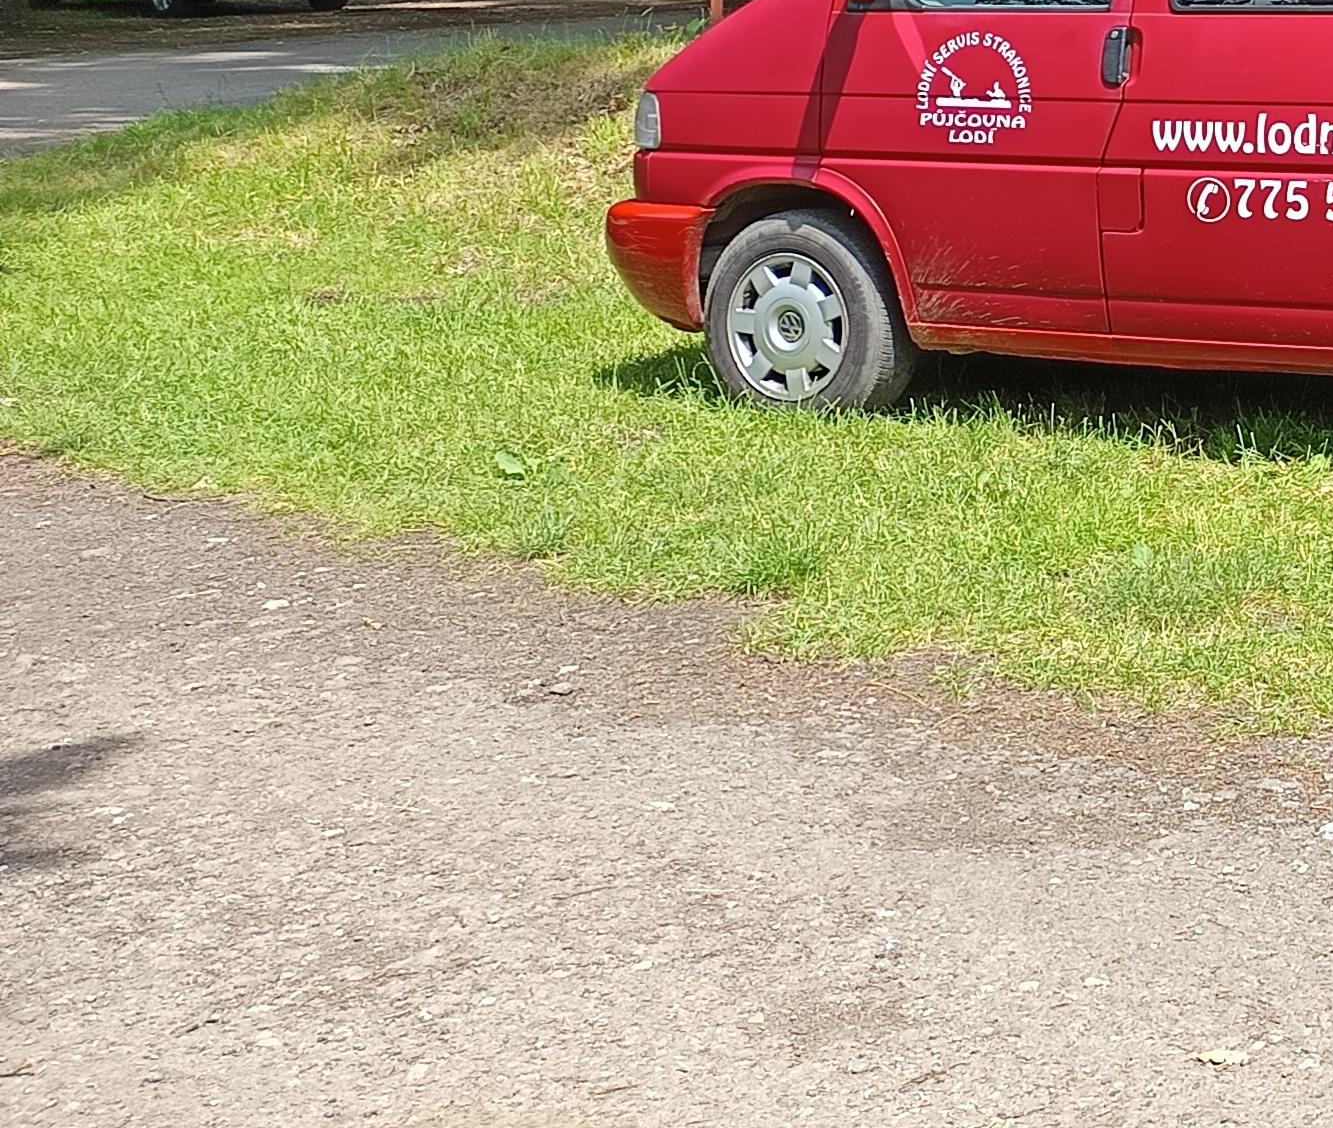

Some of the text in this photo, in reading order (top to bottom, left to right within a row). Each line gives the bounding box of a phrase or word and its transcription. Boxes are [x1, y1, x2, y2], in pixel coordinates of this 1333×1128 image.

[916, 32, 1032, 113] LODNÍ SERVIS STRAKONICE
[919, 109, 1026, 129] PŮJČOVNA
[948, 127, 998, 144] LODÍ
[1233, 178, 1309, 220] 775
